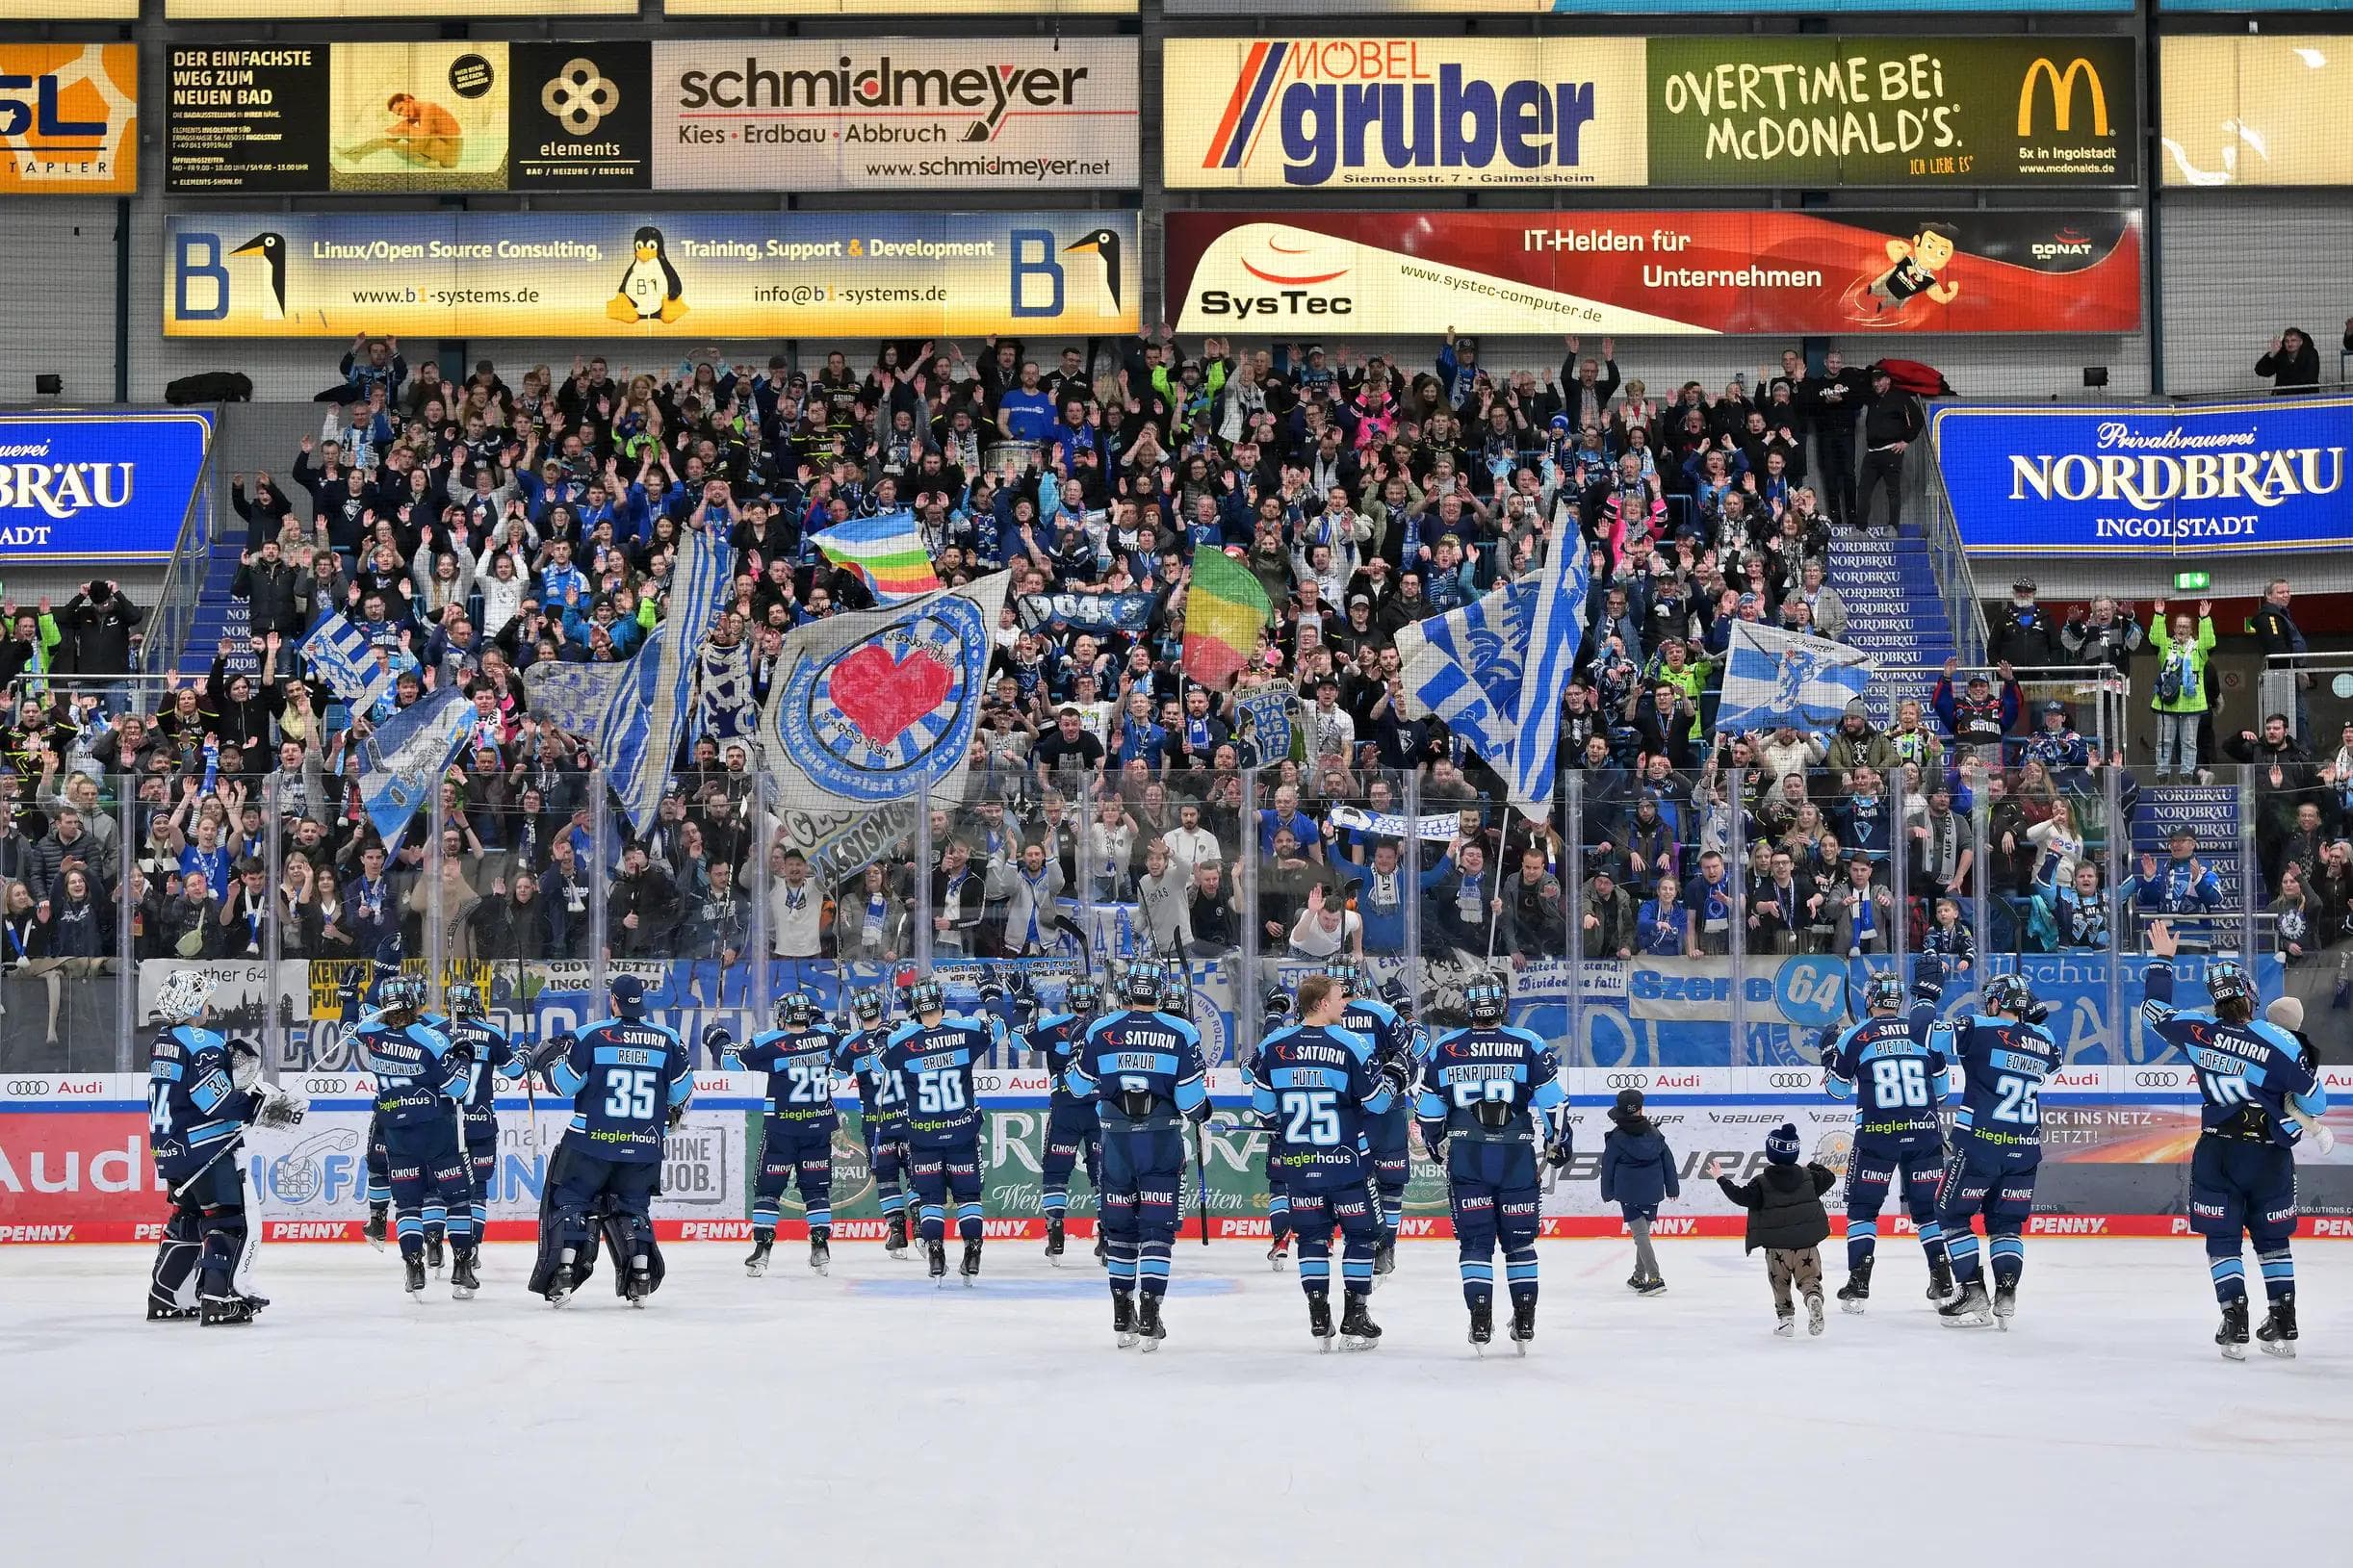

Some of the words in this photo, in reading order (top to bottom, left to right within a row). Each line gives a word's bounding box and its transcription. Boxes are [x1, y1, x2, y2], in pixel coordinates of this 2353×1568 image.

[173, 51, 208, 66] DER
[212, 50, 312, 66] EINFACHSTE
[1287, 40, 1431, 79] MÖBEL
[173, 70, 213, 86] WEG
[216, 70, 253, 86] ZUM
[680, 56, 1089, 116] schmidmeyer
[173, 90, 232, 105] NEUEN
[236, 89, 273, 105] BAD
[1280, 63, 1594, 186] gruber
[678, 123, 726, 145] Kies
[744, 123, 827, 144] Erdbau
[844, 122, 946, 143] Abbruch
[540, 141, 621, 156] elements
[2019, 147, 2034, 159] 5x
[2037, 147, 2049, 159] in
[2053, 147, 2117, 161] Ingolstadt
[526, 167, 543, 176] BAD
[553, 167, 589, 176] HEIZUNG
[866, 156, 1111, 181] www.schmidmeyer.net
[1929, 158, 1955, 174] LIEBE
[2019, 163, 2115, 173] www.mcdonalds.de
[1342, 172, 1444, 184] Siemensstr.
[1451, 173, 1461, 183] 7
[1480, 172, 1595, 184] Gaimersheim
[1523, 228, 1644, 252] IT-Helden
[1651, 228, 1692, 251] für
[313, 240, 425, 261] Linux/Open
[428, 240, 492, 259] Source
[496, 238, 603, 261] Consulting,
[681, 239, 763, 261] Training,
[766, 239, 841, 261] Support
[846, 240, 864, 257] &
[869, 239, 995, 260] Development
[2031, 244, 2092, 255] DONAT
[1642, 264, 1823, 287] Unternehmen
[352, 286, 540, 306] www.b1-systems.de
[754, 284, 947, 306] info@b1-systems.de
[1400, 262, 1603, 323] www.systec-computer.de
[1201, 289, 1353, 320] SysTec
[2097, 421, 2258, 450] Privatbrauerei
[2007, 447, 2345, 511] NORDBRÄU
[2095, 515, 2259, 538] INGOLSTADT
[1827, 541, 1895, 553] NORDBRÄU
[1829, 554, 1898, 568] NORDBRÄU
[1832, 570, 1901, 583] NORDBRÄU
[1848, 634, 1919, 648] NORDBRÄU
[2153, 788, 2232, 802] NORDBRÄU
[2154, 805, 2234, 820] NORDBRÄU
[246, 966, 269, 983] 64
[1786, 964, 1843, 1014] 64
[623, 1031, 667, 1047] SATURN
[795, 1035, 828, 1050] SATURN
[925, 1033, 966, 1050] SATURN
[1125, 1030, 1176, 1050] SATURN
[380, 1041, 423, 1061] SATURN
[617, 1049, 649, 1064] REICH
[1296, 1045, 1346, 1065] SATURN
[1470, 1041, 1524, 1058] SATURN
[1875, 1041, 1913, 1056] PIETTA
[2212, 1033, 2271, 1063] SATURN
[922, 1053, 956, 1070] BRUNE
[2197, 1049, 2247, 1076] HÖFFLIN
[1291, 1067, 1326, 1087] HÜTTL
[1447, 1065, 1516, 1082] HENRIQUEZ
[1655, 1074, 1700, 1088] Audi
[2054, 1073, 2099, 1086] Audi
[57, 1081, 103, 1095] Audi
[206, 1075, 229, 1098] 34
[917, 1068, 967, 1114] 50
[1873, 1058, 1927, 1109] 86
[605, 1068, 657, 1120] 35
[779, 1107, 834, 1122] zieglerhaus
[1282, 1091, 1342, 1146] 25
[2074, 1111, 2103, 1125] INS
[2107, 1111, 2152, 1125] NETZ
[1865, 1118, 1937, 1134] zieglerhaus
[589, 1128, 657, 1145] zieglerhaus
[391, 1166, 421, 1179] CINQUE
[803, 1160, 829, 1170] CINQUE
[915, 1161, 943, 1173] CINQUE
[1912, 1168, 1944, 1180] CINQUE
[1291, 1196, 1325, 1208] CINQUE
[1366, 1176, 1384, 1225] SATURN
[2002, 1188, 2033, 1199] CINQUE
[1461, 1196, 1494, 1209] CINQUE
[1502, 1202, 1536, 1214] CINQUE
[2193, 1201, 2225, 1216] CINQUE
